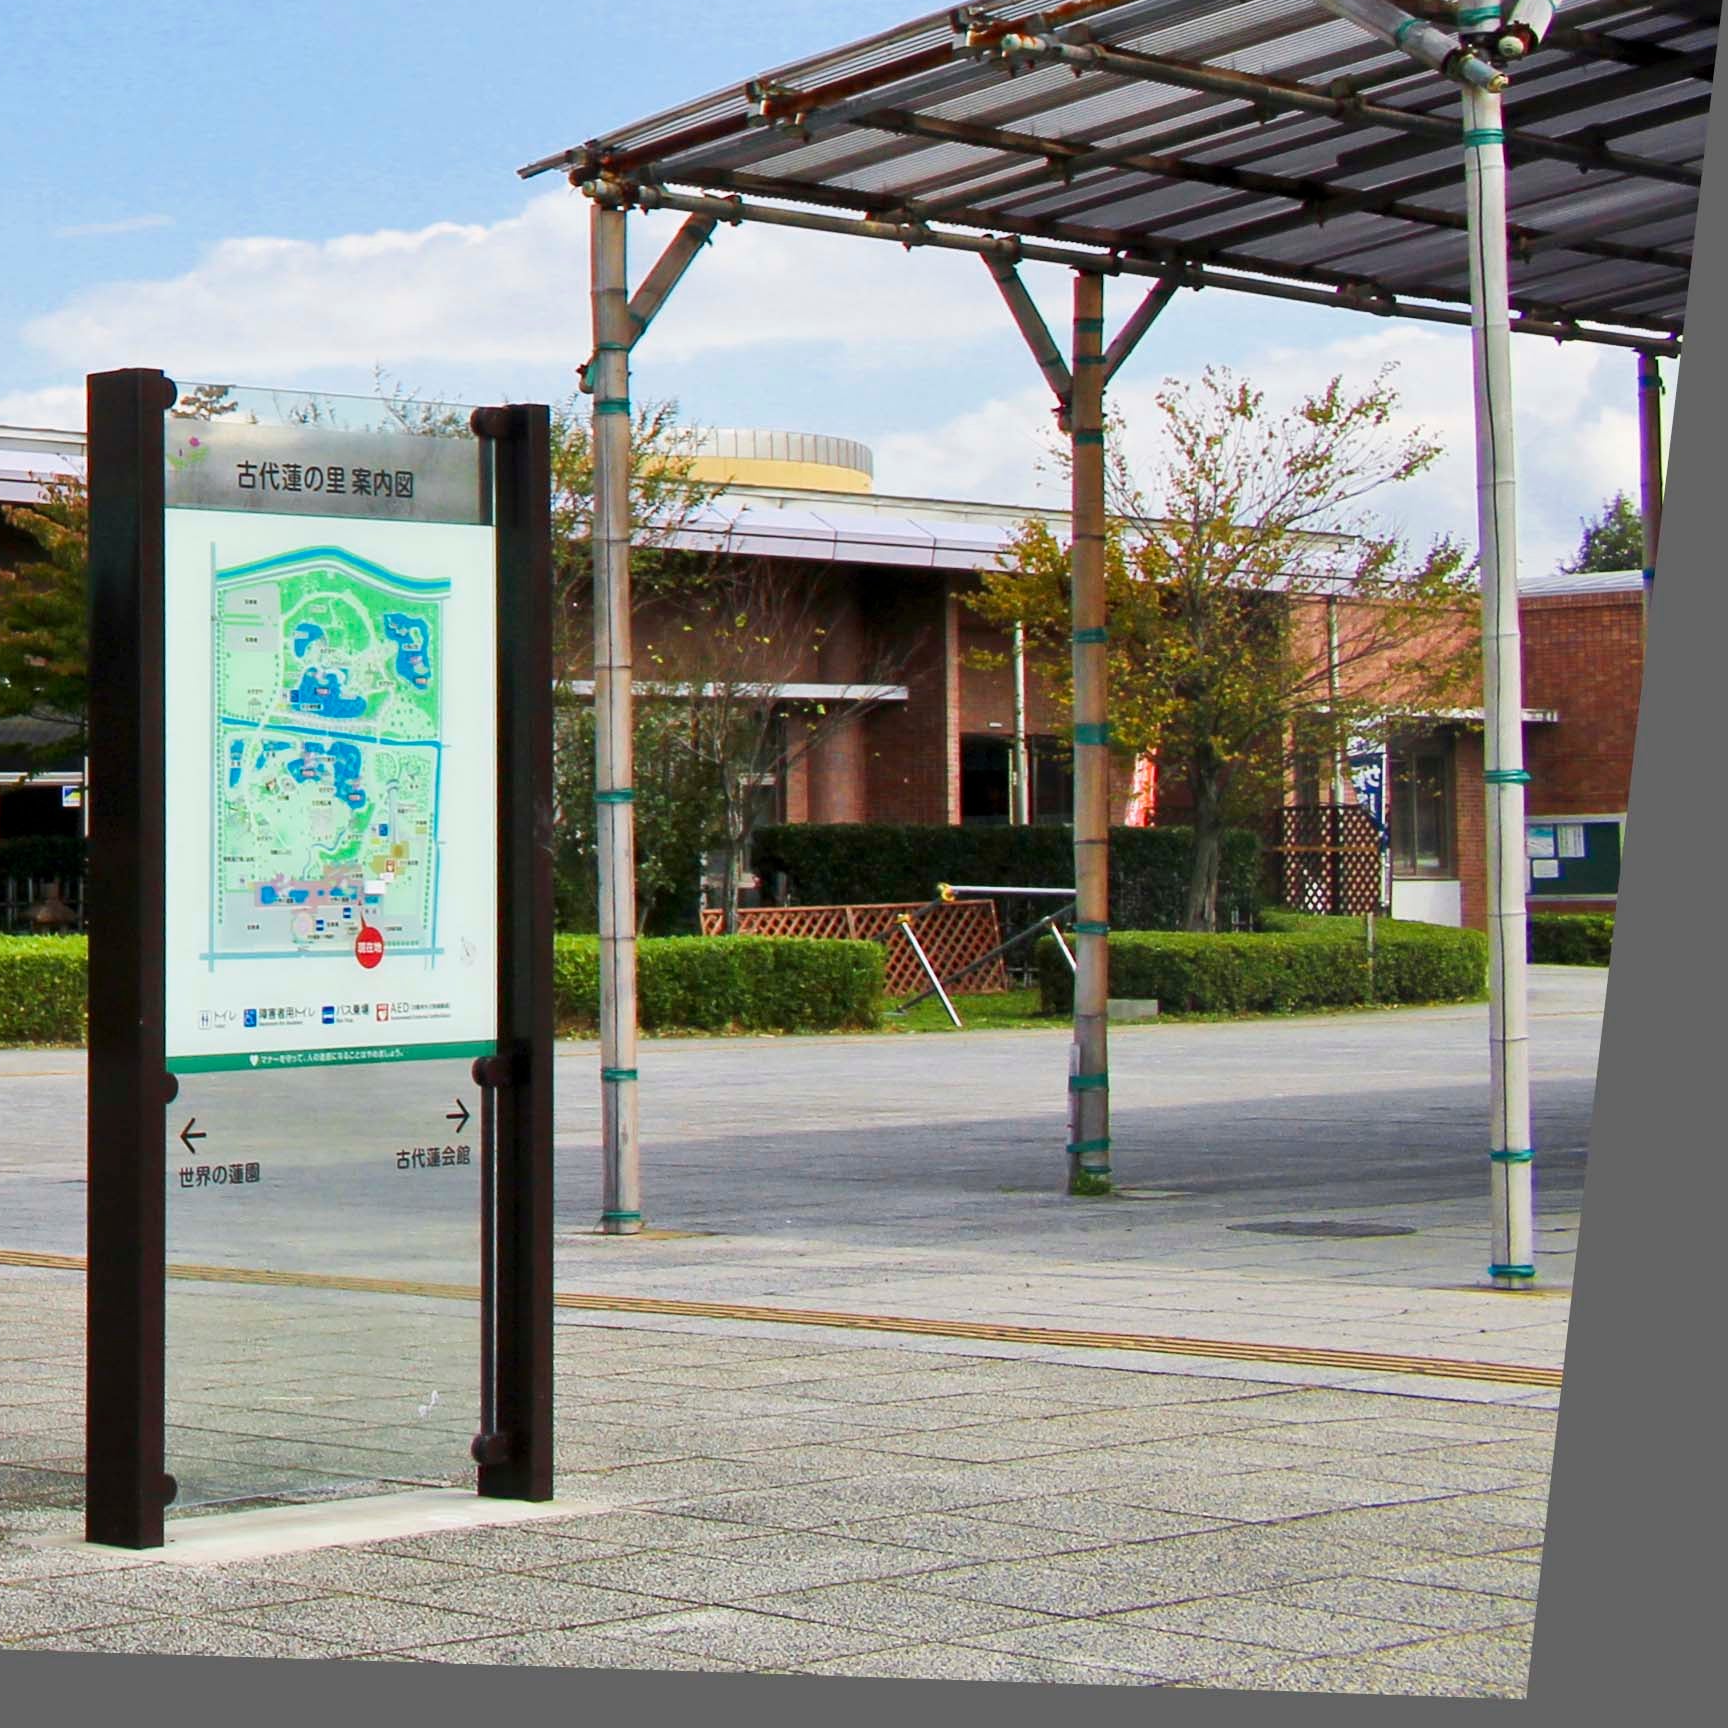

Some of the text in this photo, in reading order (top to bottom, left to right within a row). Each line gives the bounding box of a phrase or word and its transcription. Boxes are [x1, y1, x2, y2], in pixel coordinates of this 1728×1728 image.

[236, 460, 414, 498] 古代蓮の里 案内図
[213, 1008, 236, 1022] トイレ
[258, 1006, 316, 1021] 障害者用トイレ
[336, 1003, 370, 1016] バス乗場
[390, 1002, 410, 1014] AED
[396, 1145, 471, 1169] 古代蓮会館
[179, 1162, 260, 1188] 世界の蓮園
